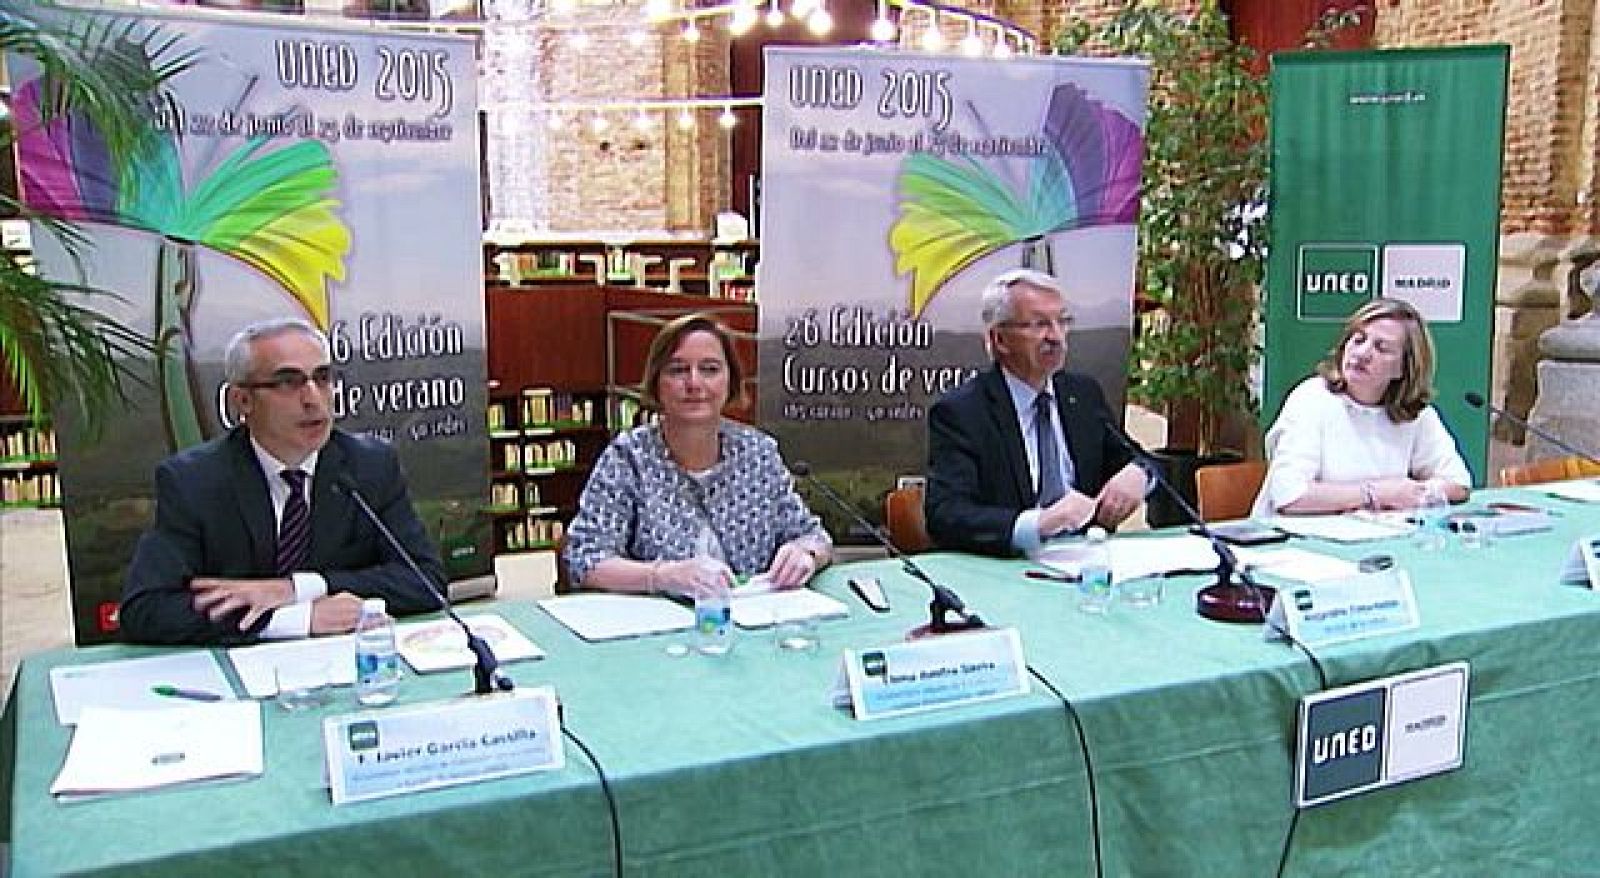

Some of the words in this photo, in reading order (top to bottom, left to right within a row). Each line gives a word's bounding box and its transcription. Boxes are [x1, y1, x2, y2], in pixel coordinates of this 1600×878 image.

[275, 39, 357, 89] UNED
[375, 47, 453, 118] 2015
[790, 65, 862, 108] UNED
[877, 69, 953, 131] 2015
[1306, 273, 1369, 293] UNED
[331, 319, 352, 363] 6
[360, 312, 463, 361] Edición
[784, 309, 819, 349] 26
[829, 303, 935, 349] Edición
[783, 354, 870, 395] Cursos
[881, 354, 914, 395] de
[921, 367, 978, 394] ver
[333, 377, 363, 419] de
[370, 376, 464, 414] verano
[1314, 725, 1376, 765] UNED
